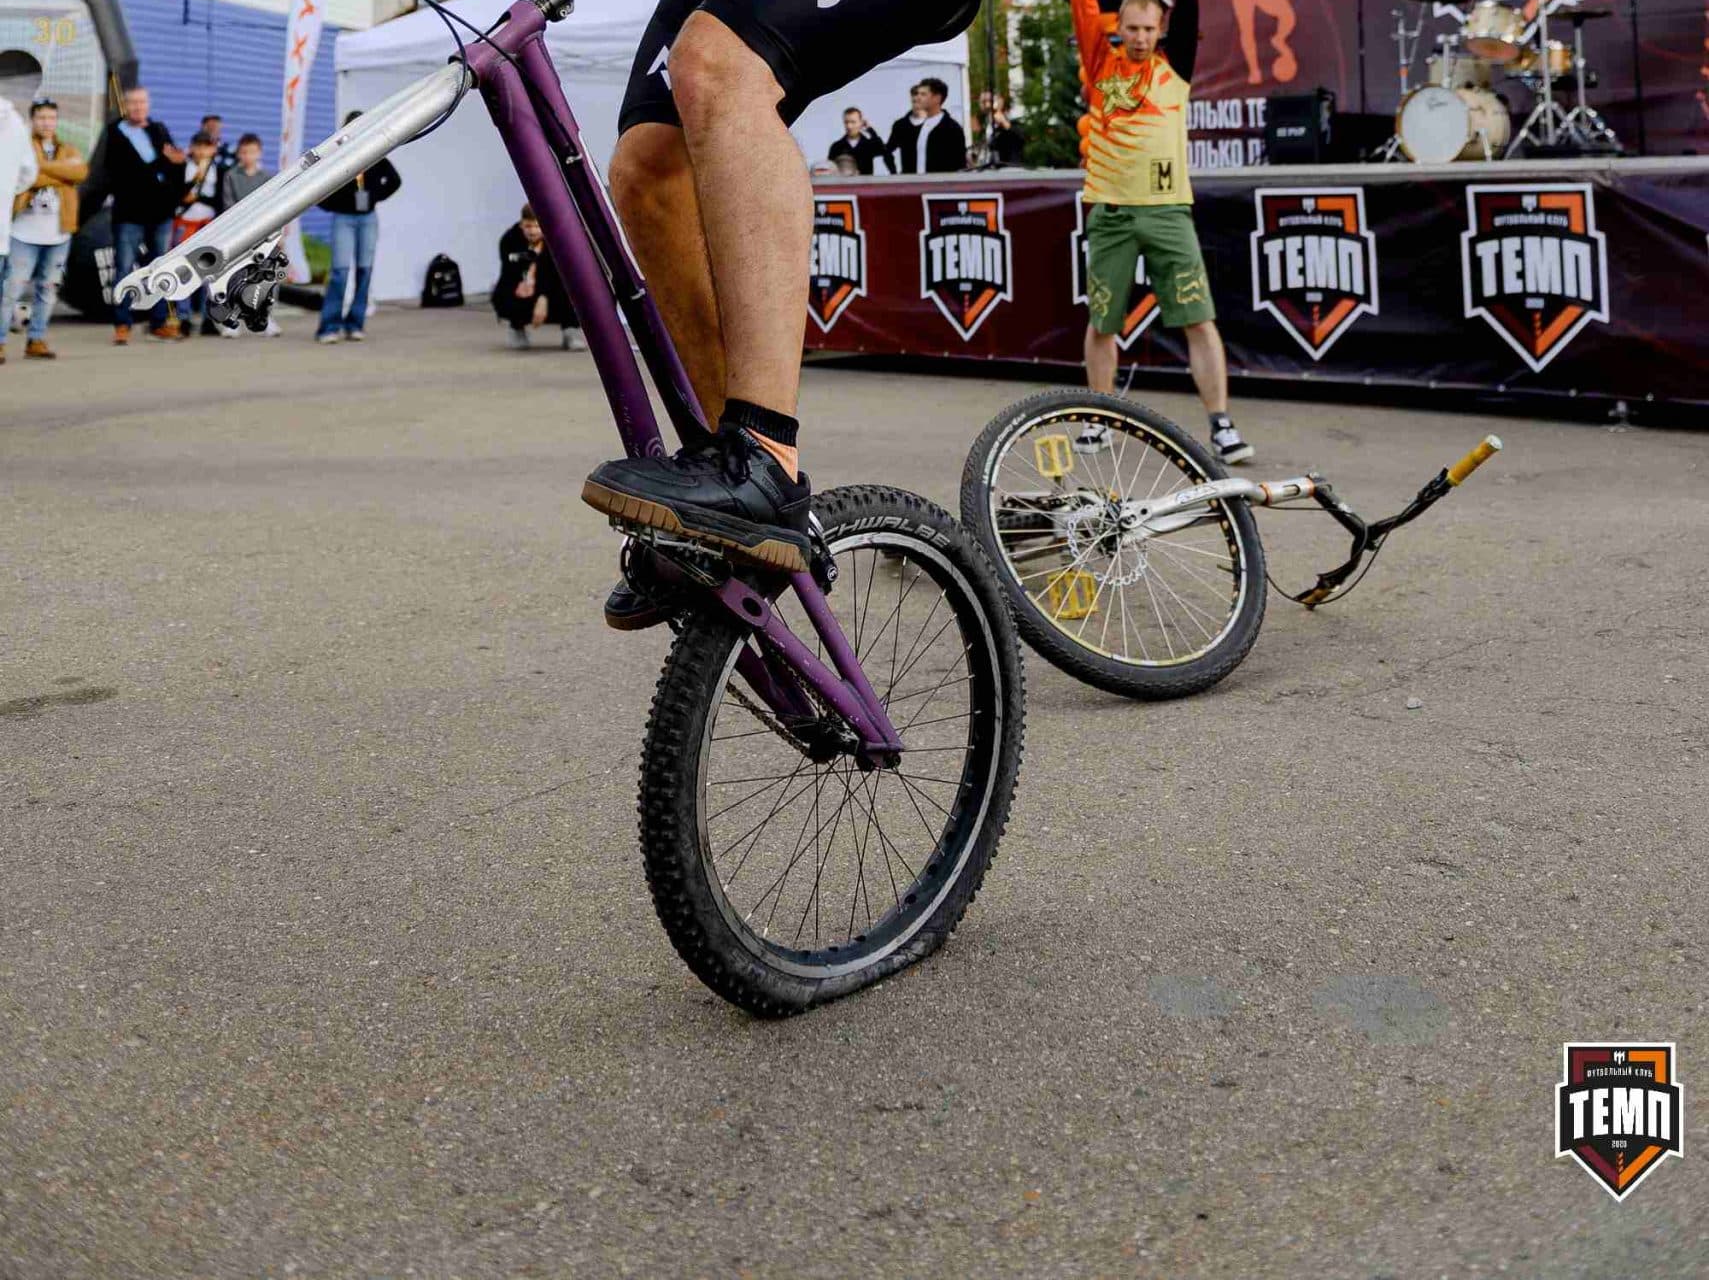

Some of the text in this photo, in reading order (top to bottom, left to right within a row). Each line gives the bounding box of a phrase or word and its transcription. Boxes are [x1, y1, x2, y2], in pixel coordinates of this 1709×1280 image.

[810, 232, 858, 282] ЕМП
[928, 234, 1003, 286] ТЕМП
[1263, 235, 1365, 296] ТЕМП
[1475, 236, 1594, 302] ТЕМП
[822, 516, 952, 548] CHWALBE
